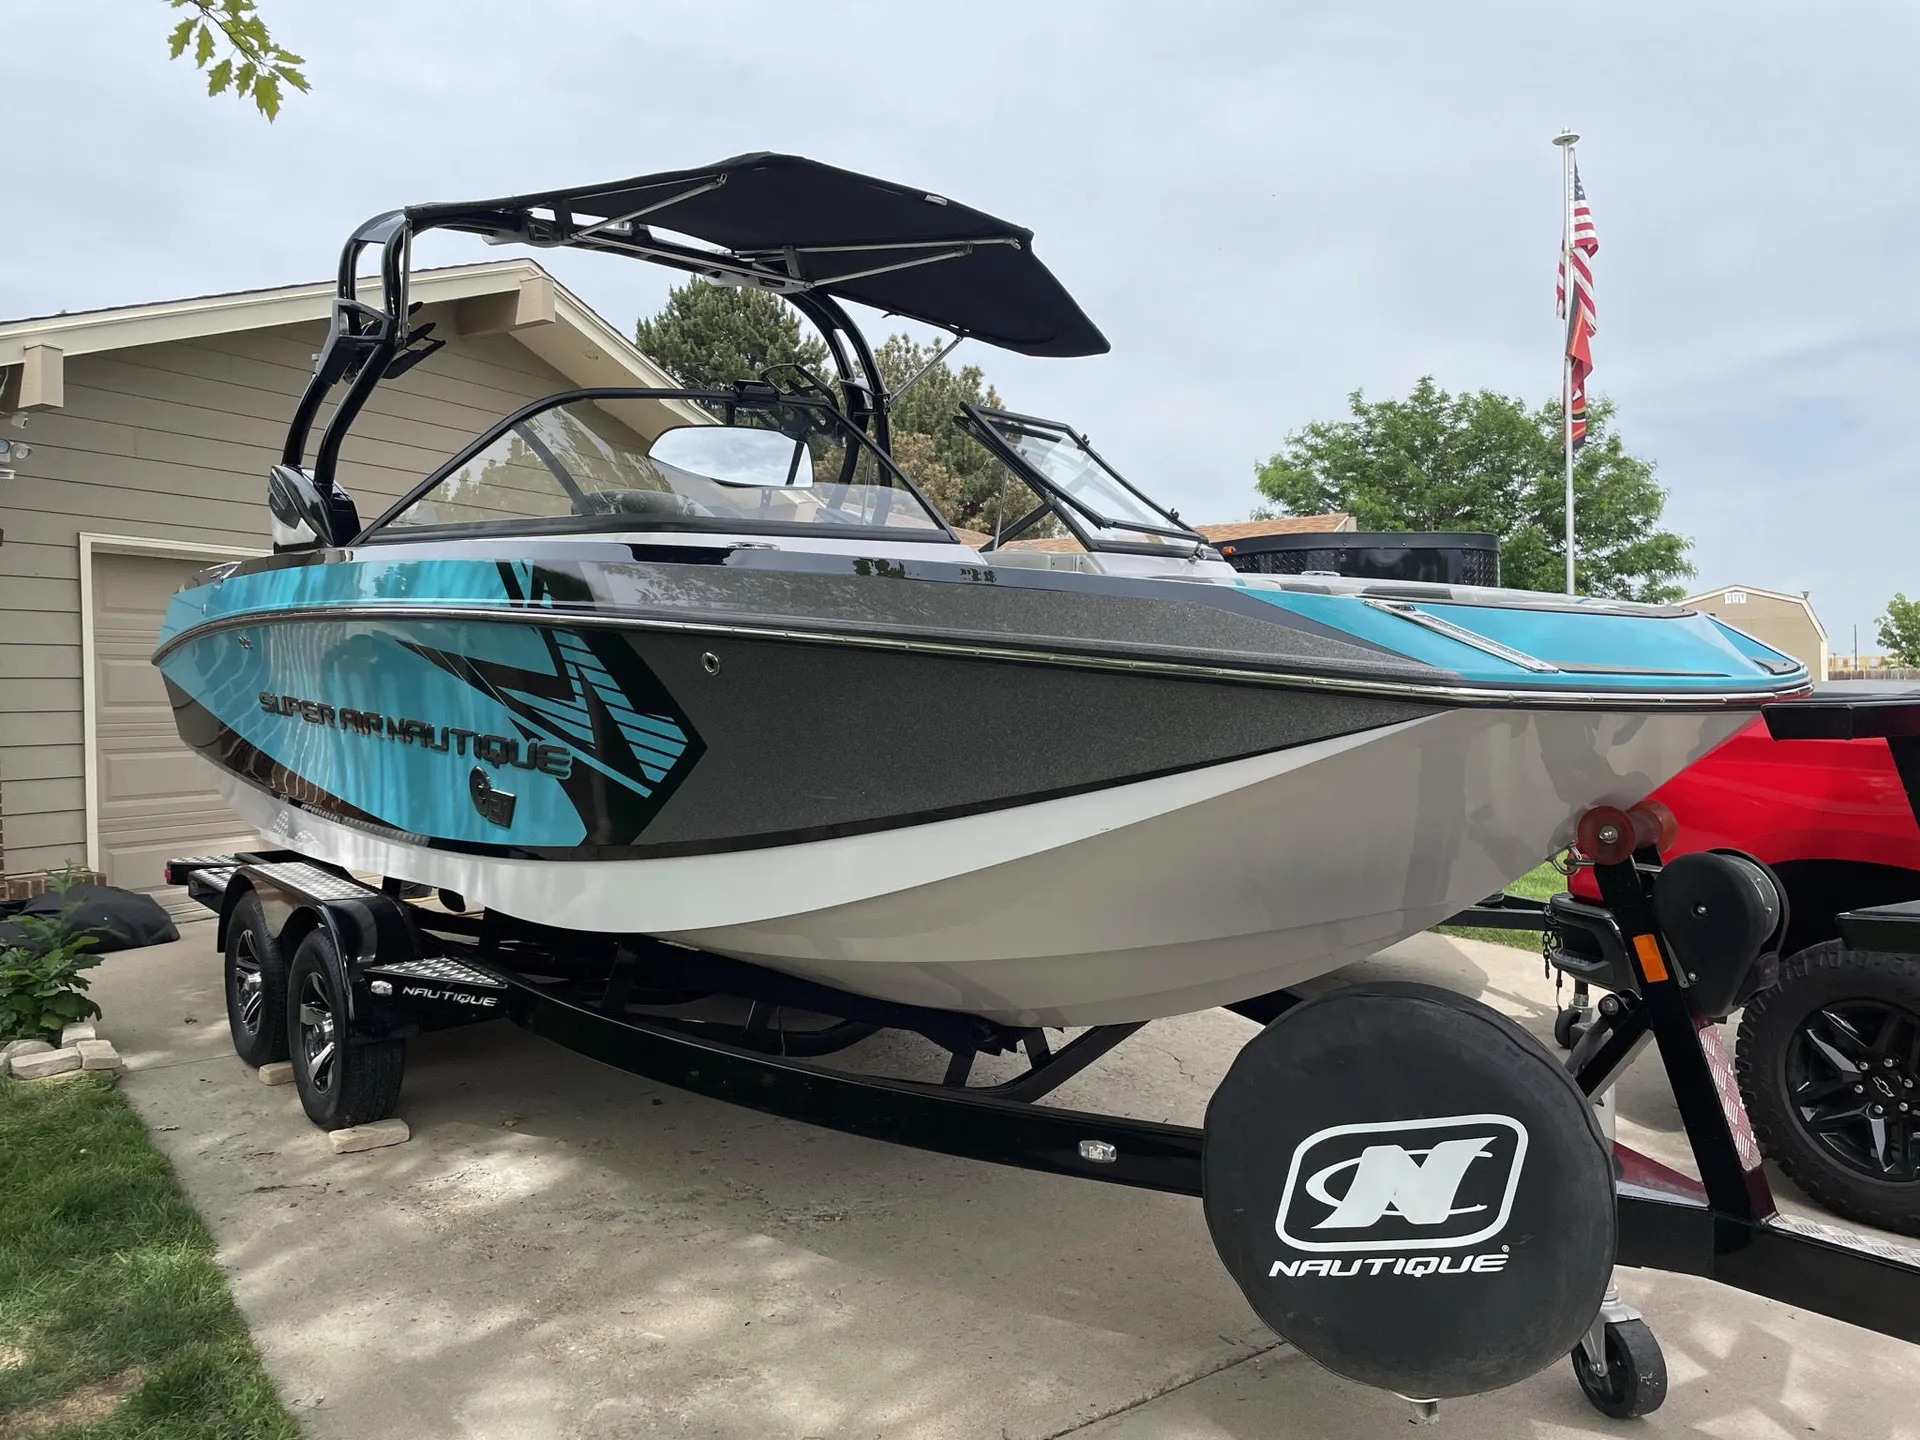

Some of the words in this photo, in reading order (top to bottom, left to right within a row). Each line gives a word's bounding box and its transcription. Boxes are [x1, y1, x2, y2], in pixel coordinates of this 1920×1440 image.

[259, 691, 336, 728] SUPER
[339, 707, 384, 738] AIR
[387, 714, 571, 777] NAUTIQUE
[402, 986, 498, 1007] NAUTIQUE
